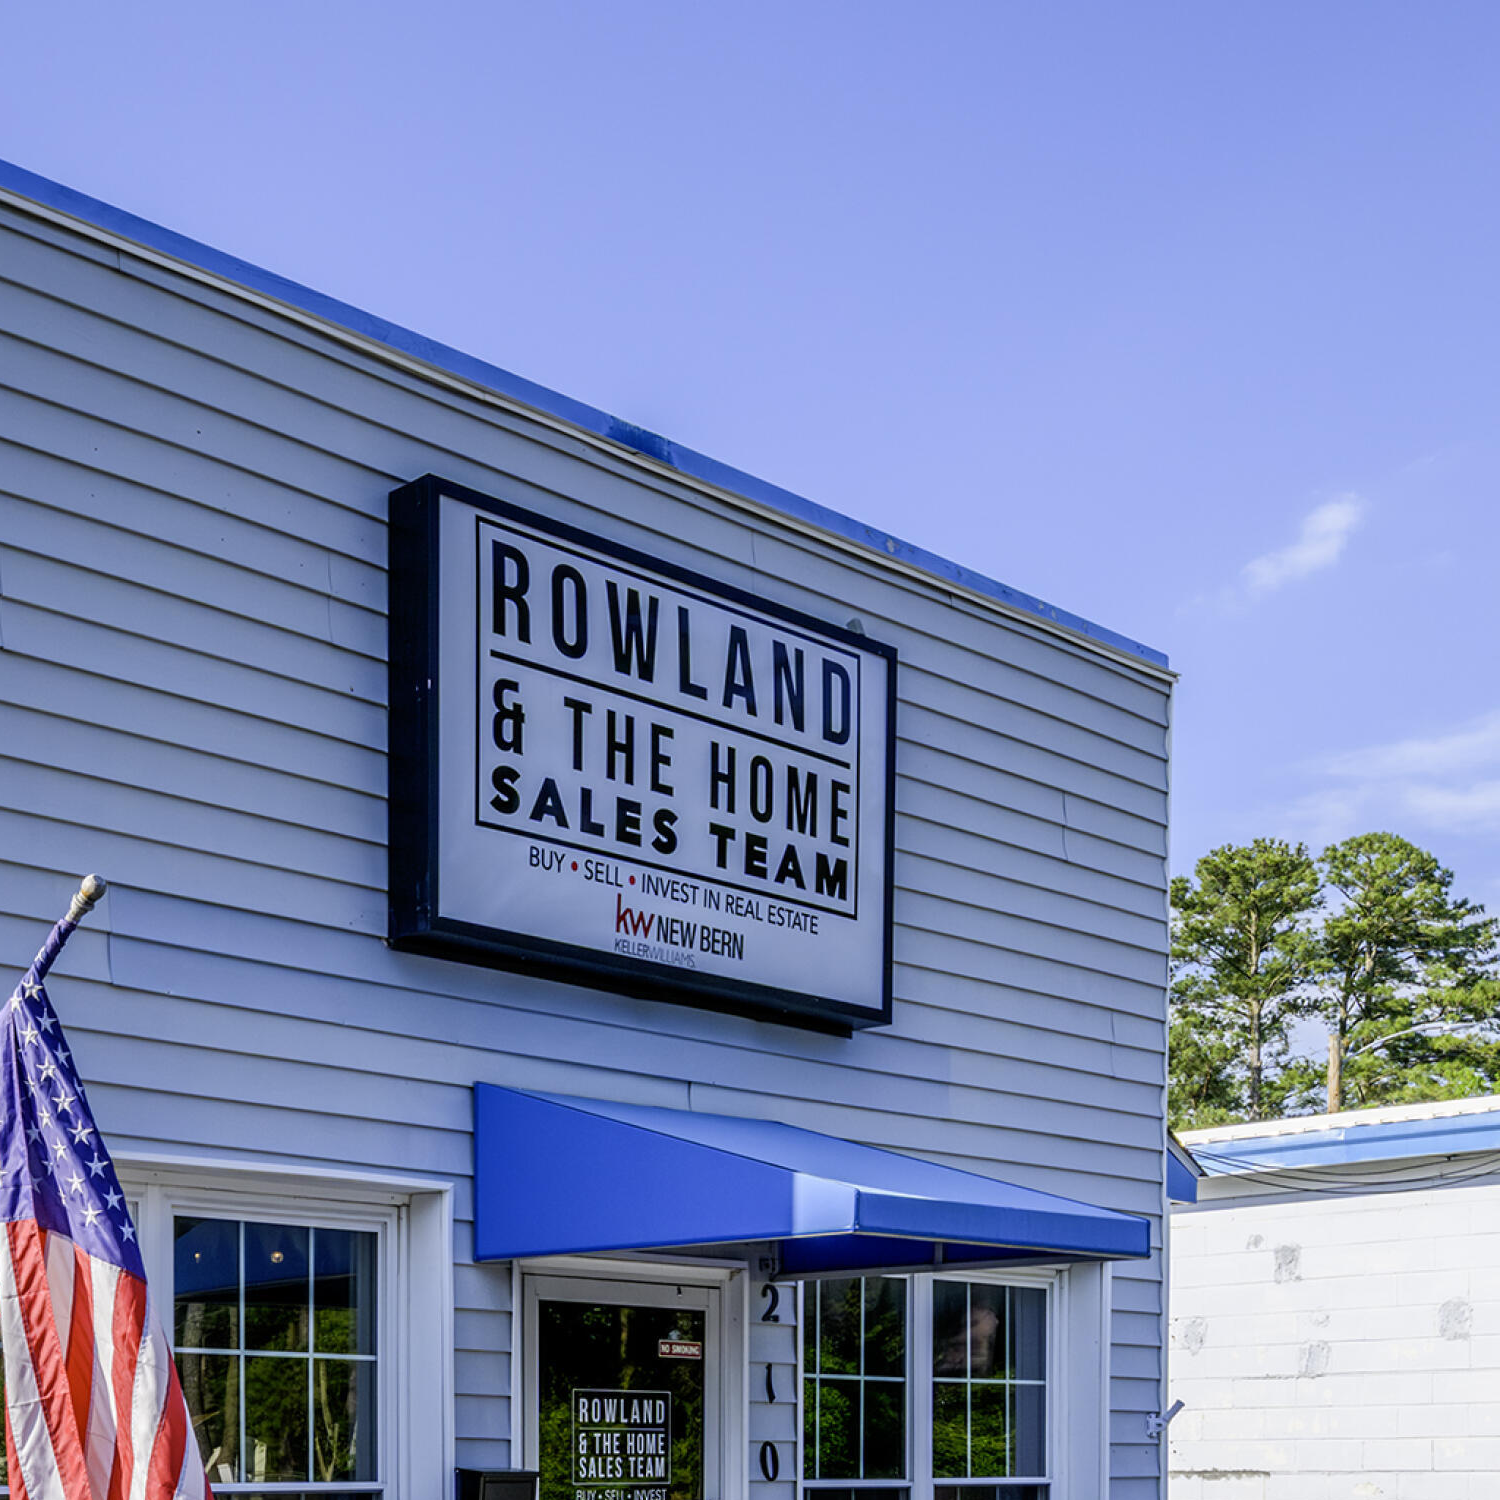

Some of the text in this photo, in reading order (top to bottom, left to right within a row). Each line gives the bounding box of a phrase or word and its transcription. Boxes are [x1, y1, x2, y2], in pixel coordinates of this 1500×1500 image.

[491, 538, 851, 745] ROWLAND
[492, 677, 850, 848] & THE HOME
[489, 765, 849, 901] SALES TEAM
[529, 846, 819, 935] BUY SELL INVEST IN REAL ESTATE
[615, 892, 744, 961] kw NEW BERN
[661, 1344, 700, 1356] NO SMOKING
[579, 1398, 665, 1424] ROWLAND
[579, 1432, 665, 1455] & THE HOME
[579, 1457, 665, 1479] SALES TEAM
